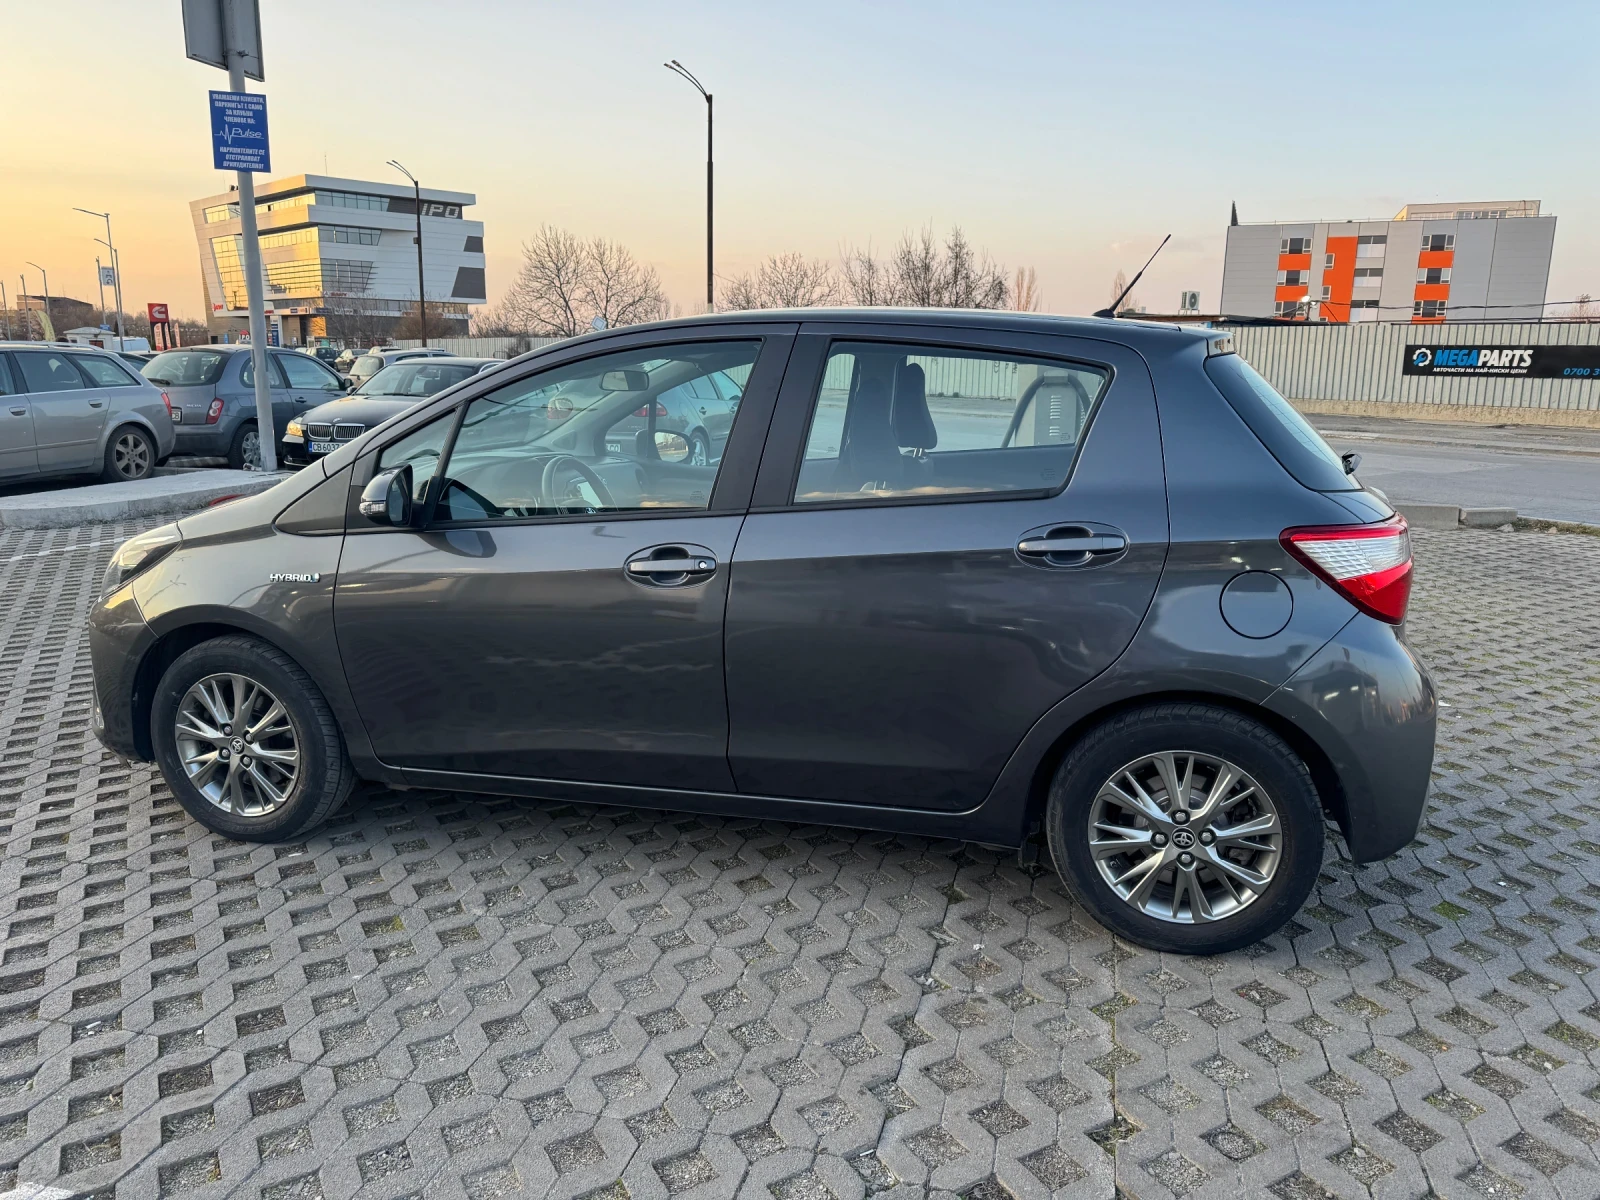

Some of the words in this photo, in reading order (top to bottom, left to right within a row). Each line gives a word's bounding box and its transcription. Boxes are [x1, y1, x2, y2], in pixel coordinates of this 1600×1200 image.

[232, 128, 262, 138] Pulse
[422, 203, 459, 218] IPO
[1434, 349, 1534, 367] MEGAPARTS
[1563, 367, 1591, 376] 0700
[1592, 368, 1600, 376] 3
[269, 573, 311, 582] HYBRID
